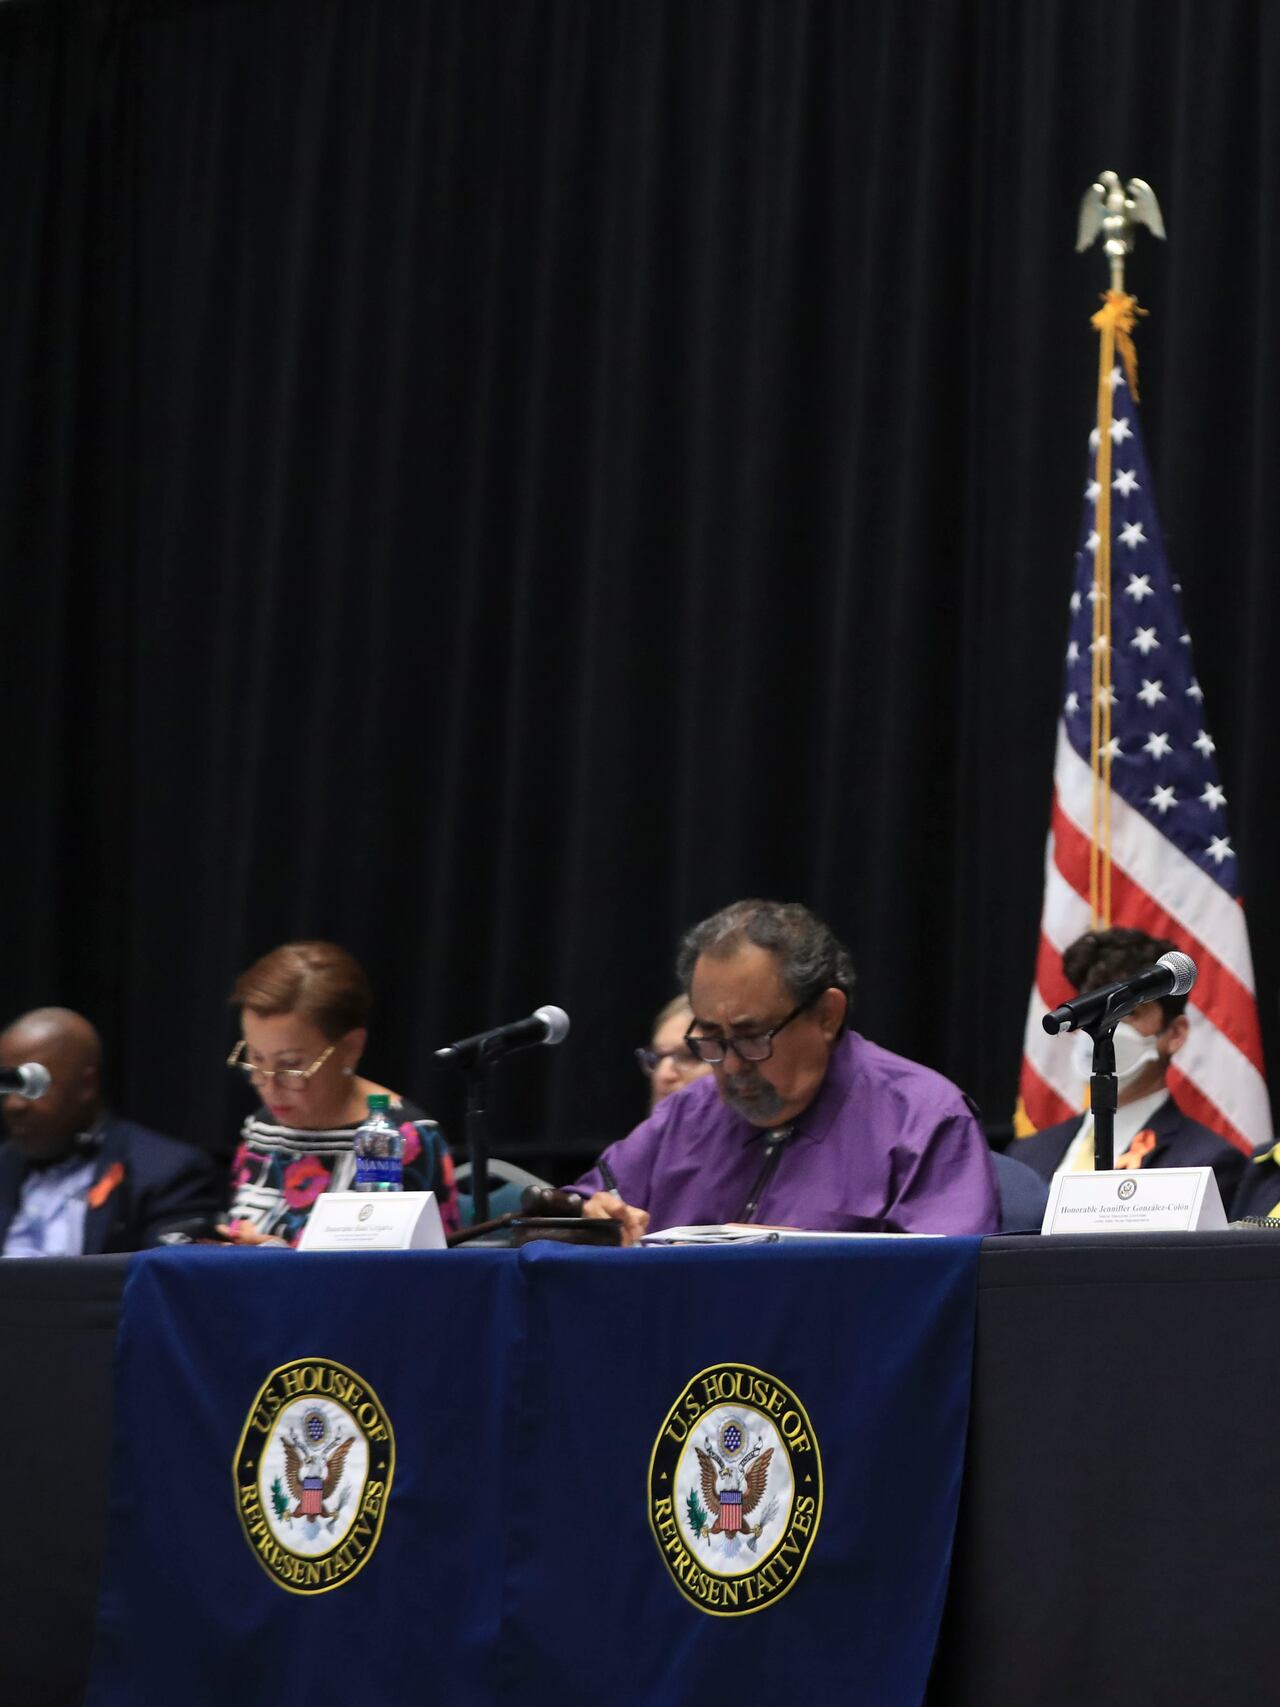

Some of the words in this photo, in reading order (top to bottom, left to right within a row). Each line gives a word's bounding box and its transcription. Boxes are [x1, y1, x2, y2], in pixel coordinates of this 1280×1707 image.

[1061, 1205, 1097, 1214] Honorable
[279, 1366, 364, 1409] HOUSE
[357, 1404, 390, 1442] OF
[664, 1395, 705, 1443] U.S.
[700, 1372, 787, 1418] HOUSE
[780, 1410, 811, 1453] OF
[240, 1480, 385, 1585] REPRESENTATIVES
[655, 1495, 815, 1606] REPRESENTATIVES
